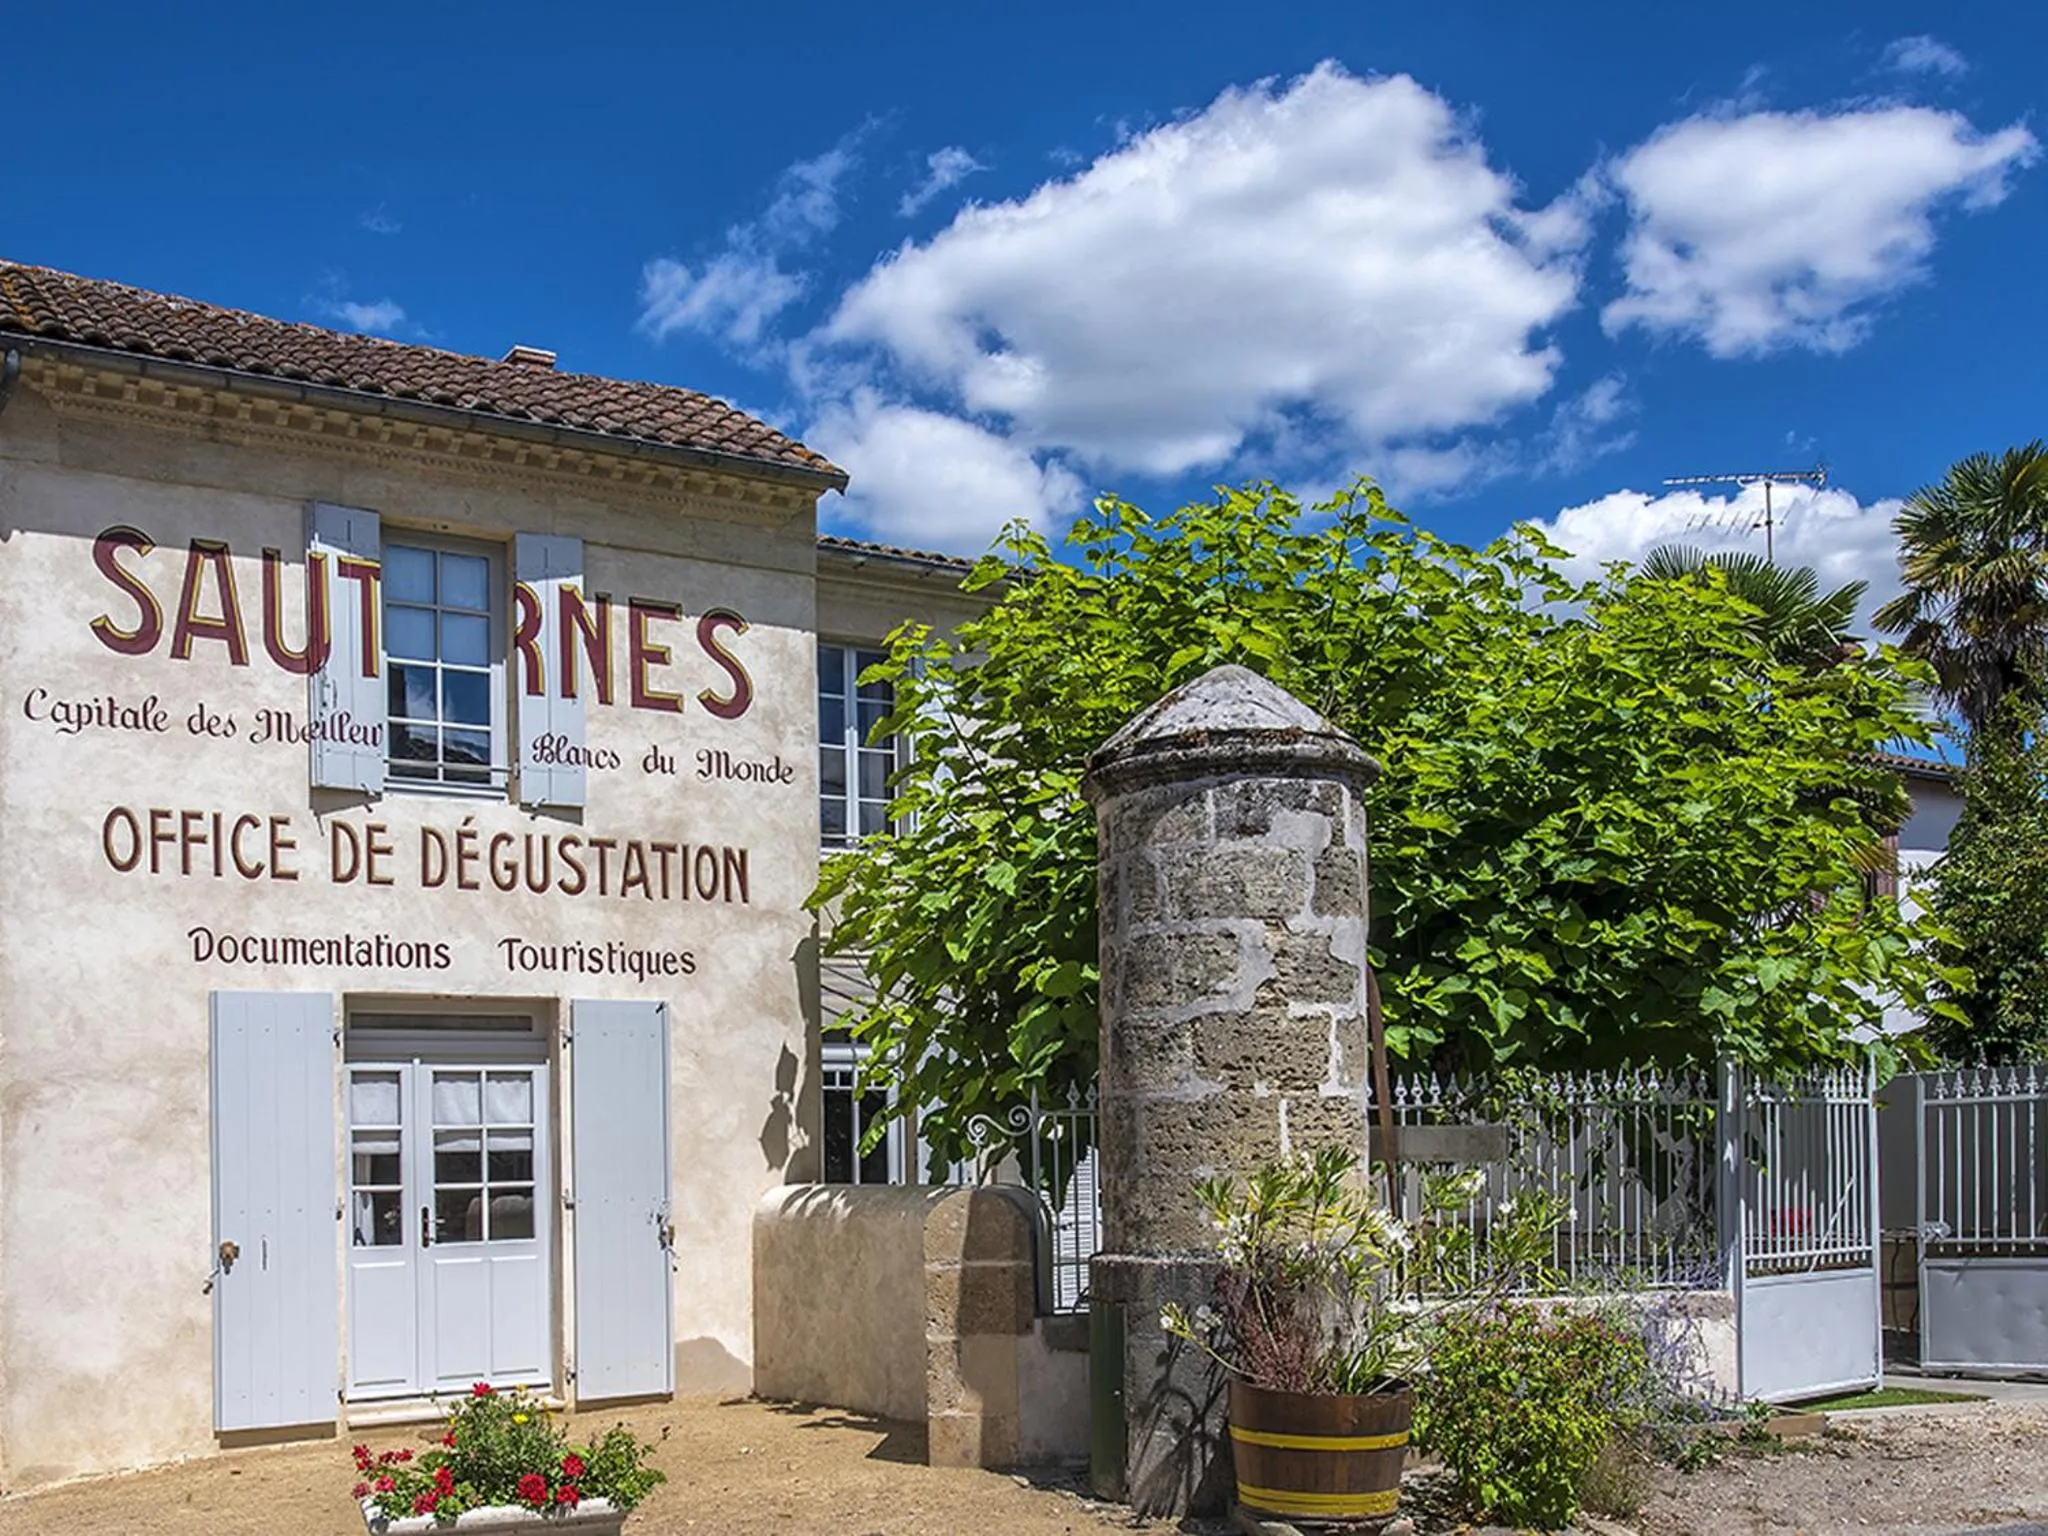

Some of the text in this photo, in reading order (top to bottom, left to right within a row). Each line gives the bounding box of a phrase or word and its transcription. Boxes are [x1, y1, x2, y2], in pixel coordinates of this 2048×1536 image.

[24, 688, 169, 734] Capitale
[187, 703, 237, 738] des
[532, 732, 621, 769] Blancs
[642, 745, 675, 775] du
[696, 749, 795, 785] Monde
[103, 806, 749, 903] OFFICE DE DÉGUSTATION
[188, 926, 697, 983] Documentations Touristiques
